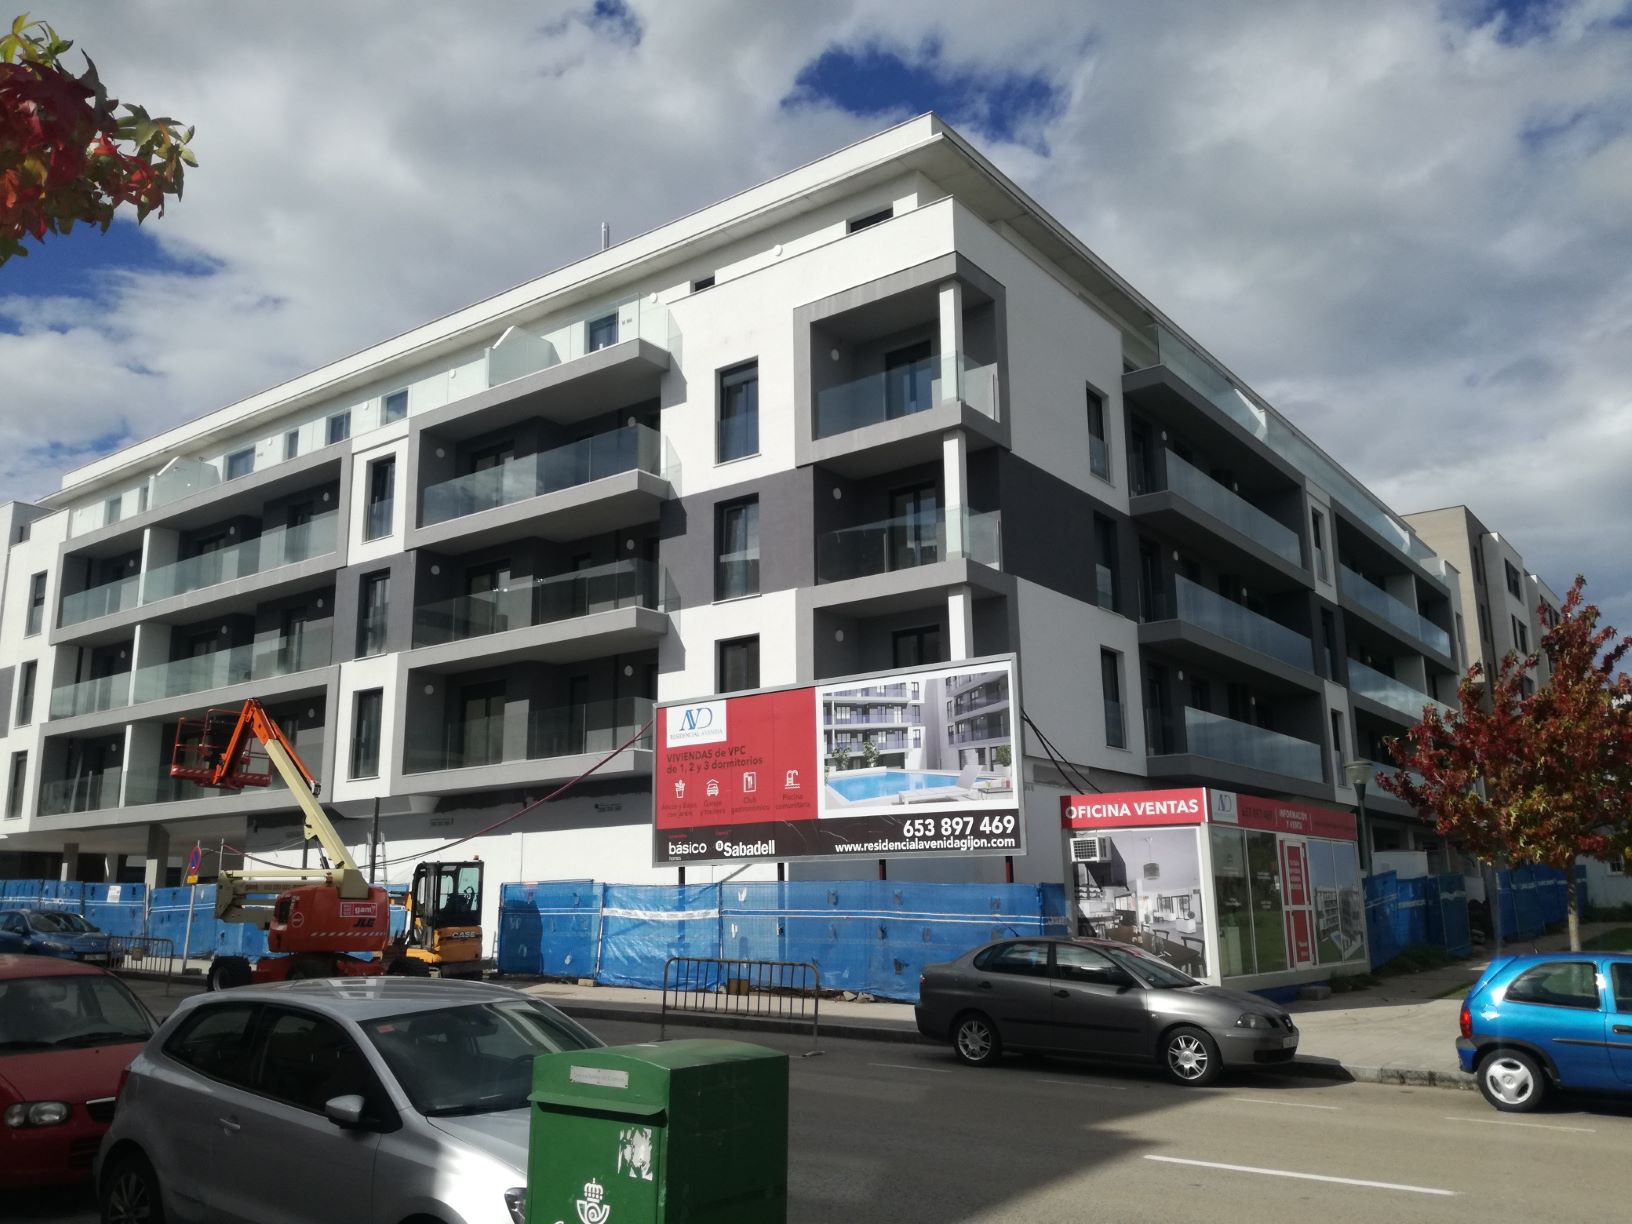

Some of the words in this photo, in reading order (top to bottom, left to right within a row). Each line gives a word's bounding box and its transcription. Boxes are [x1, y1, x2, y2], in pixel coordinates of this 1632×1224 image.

[667, 750, 713, 763] VIVIENDAS
[715, 748, 726, 758] de
[728, 746, 746, 756] VPC
[666, 764, 678, 774] de
[681, 763, 687, 773] 1,
[689, 762, 695, 771] 2
[703, 761, 709, 770] 3
[711, 756, 763, 770] dormitorios
[1065, 802, 1132, 819] OFICINA
[1134, 799, 1199, 816] VENTAS
[903, 818, 935, 837] 653
[941, 817, 974, 836] 897
[980, 815, 1016, 835] 469
[668, 841, 707, 855] básico
[724, 839, 776, 857] Sabadell
[834, 836, 1016, 853] www.residencialavenidagijon.com
[452, 931, 476, 939] CASE
